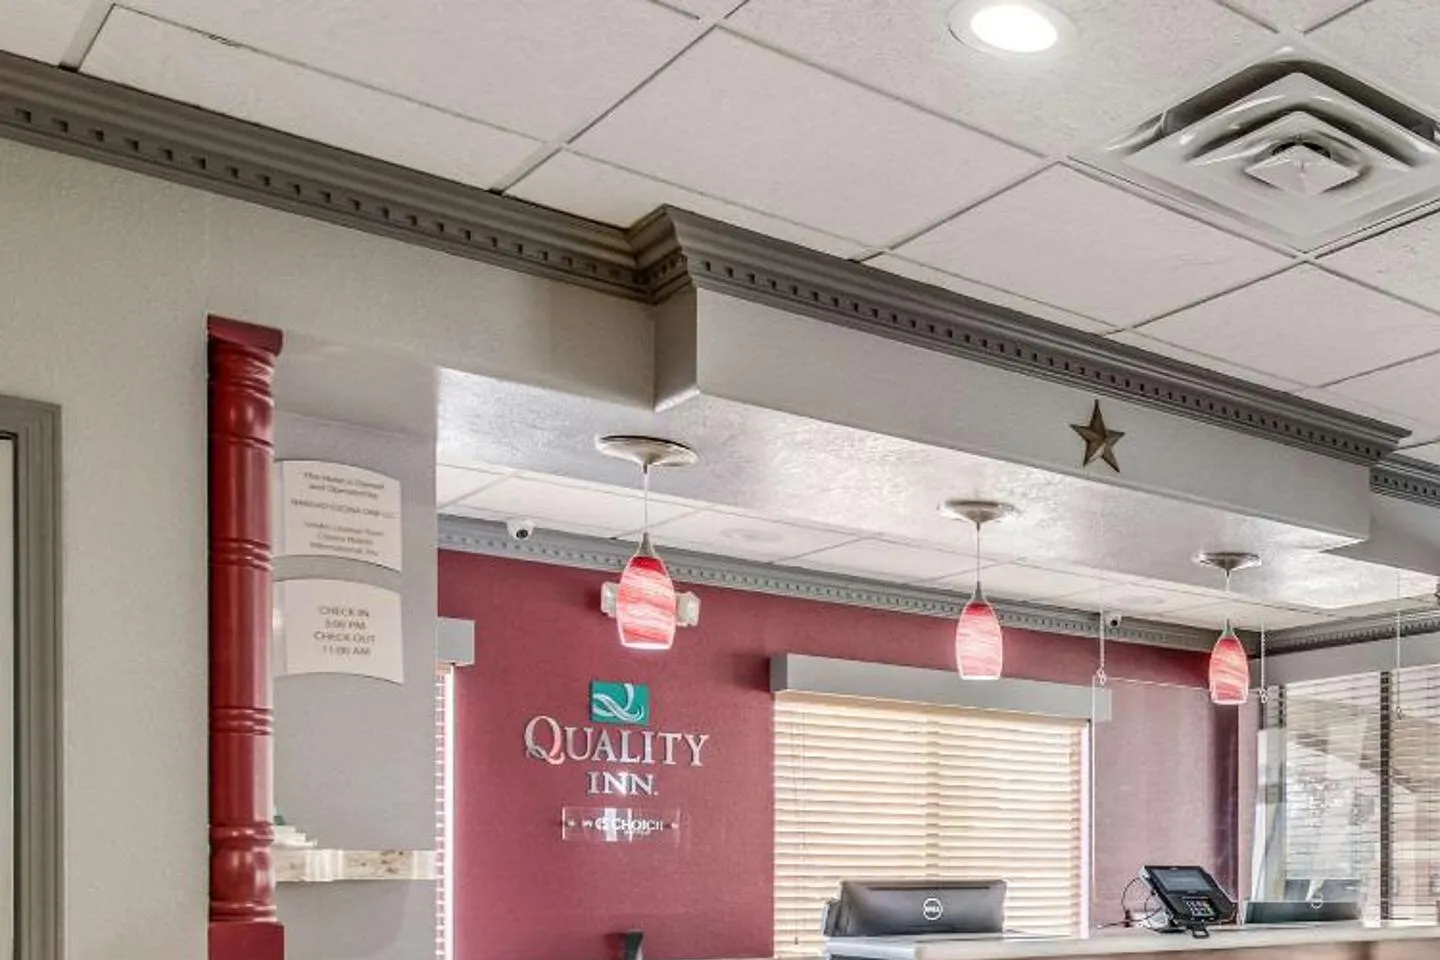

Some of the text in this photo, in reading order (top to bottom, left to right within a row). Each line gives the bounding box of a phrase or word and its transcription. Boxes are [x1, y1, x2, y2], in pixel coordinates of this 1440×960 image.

[318, 605, 354, 617] CHECK
[348, 621, 366, 630] PM
[313, 631, 376, 644] CHECK OUT
[352, 646, 371, 656] AM
[524, 715, 710, 767] QUALITY
